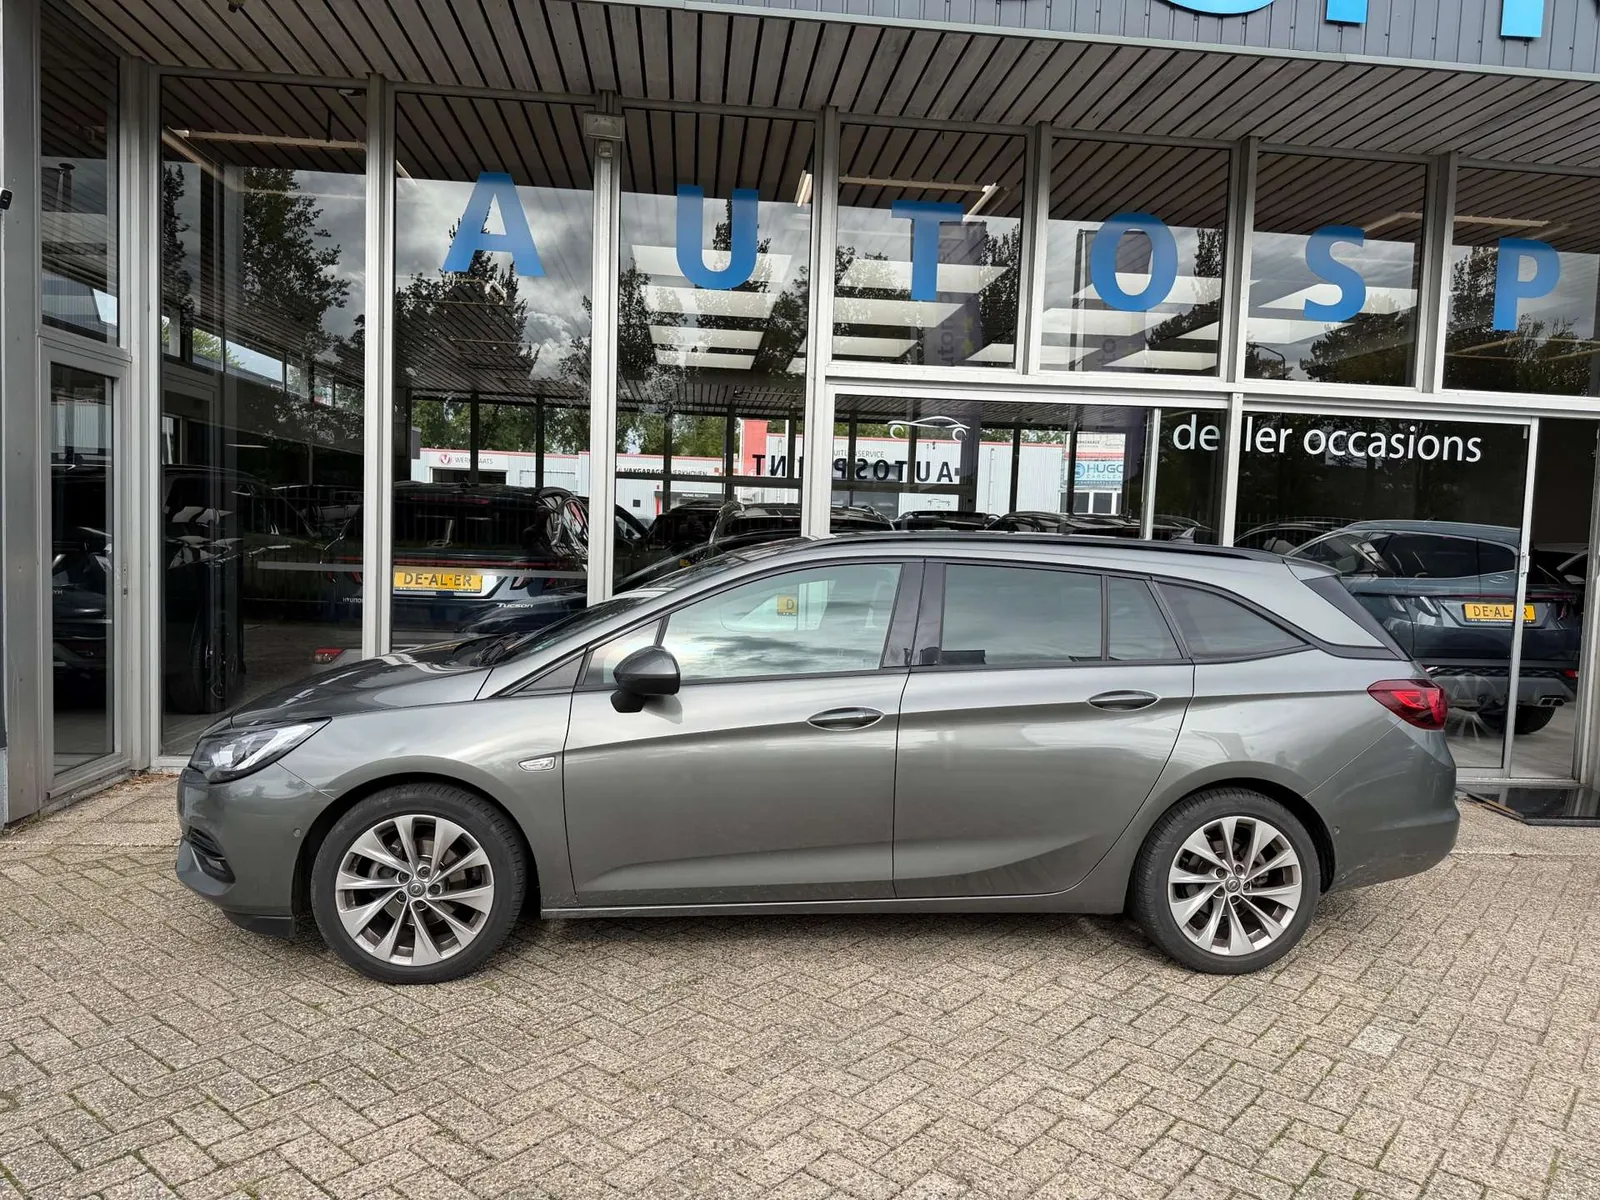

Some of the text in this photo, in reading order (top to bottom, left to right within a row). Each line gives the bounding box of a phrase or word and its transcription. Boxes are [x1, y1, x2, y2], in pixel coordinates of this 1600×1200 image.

[1172, 413, 1482, 463] deler occasions
[403, 573, 472, 587] DE-AL-ER
[1473, 605, 1528, 618] DE-AL-R
